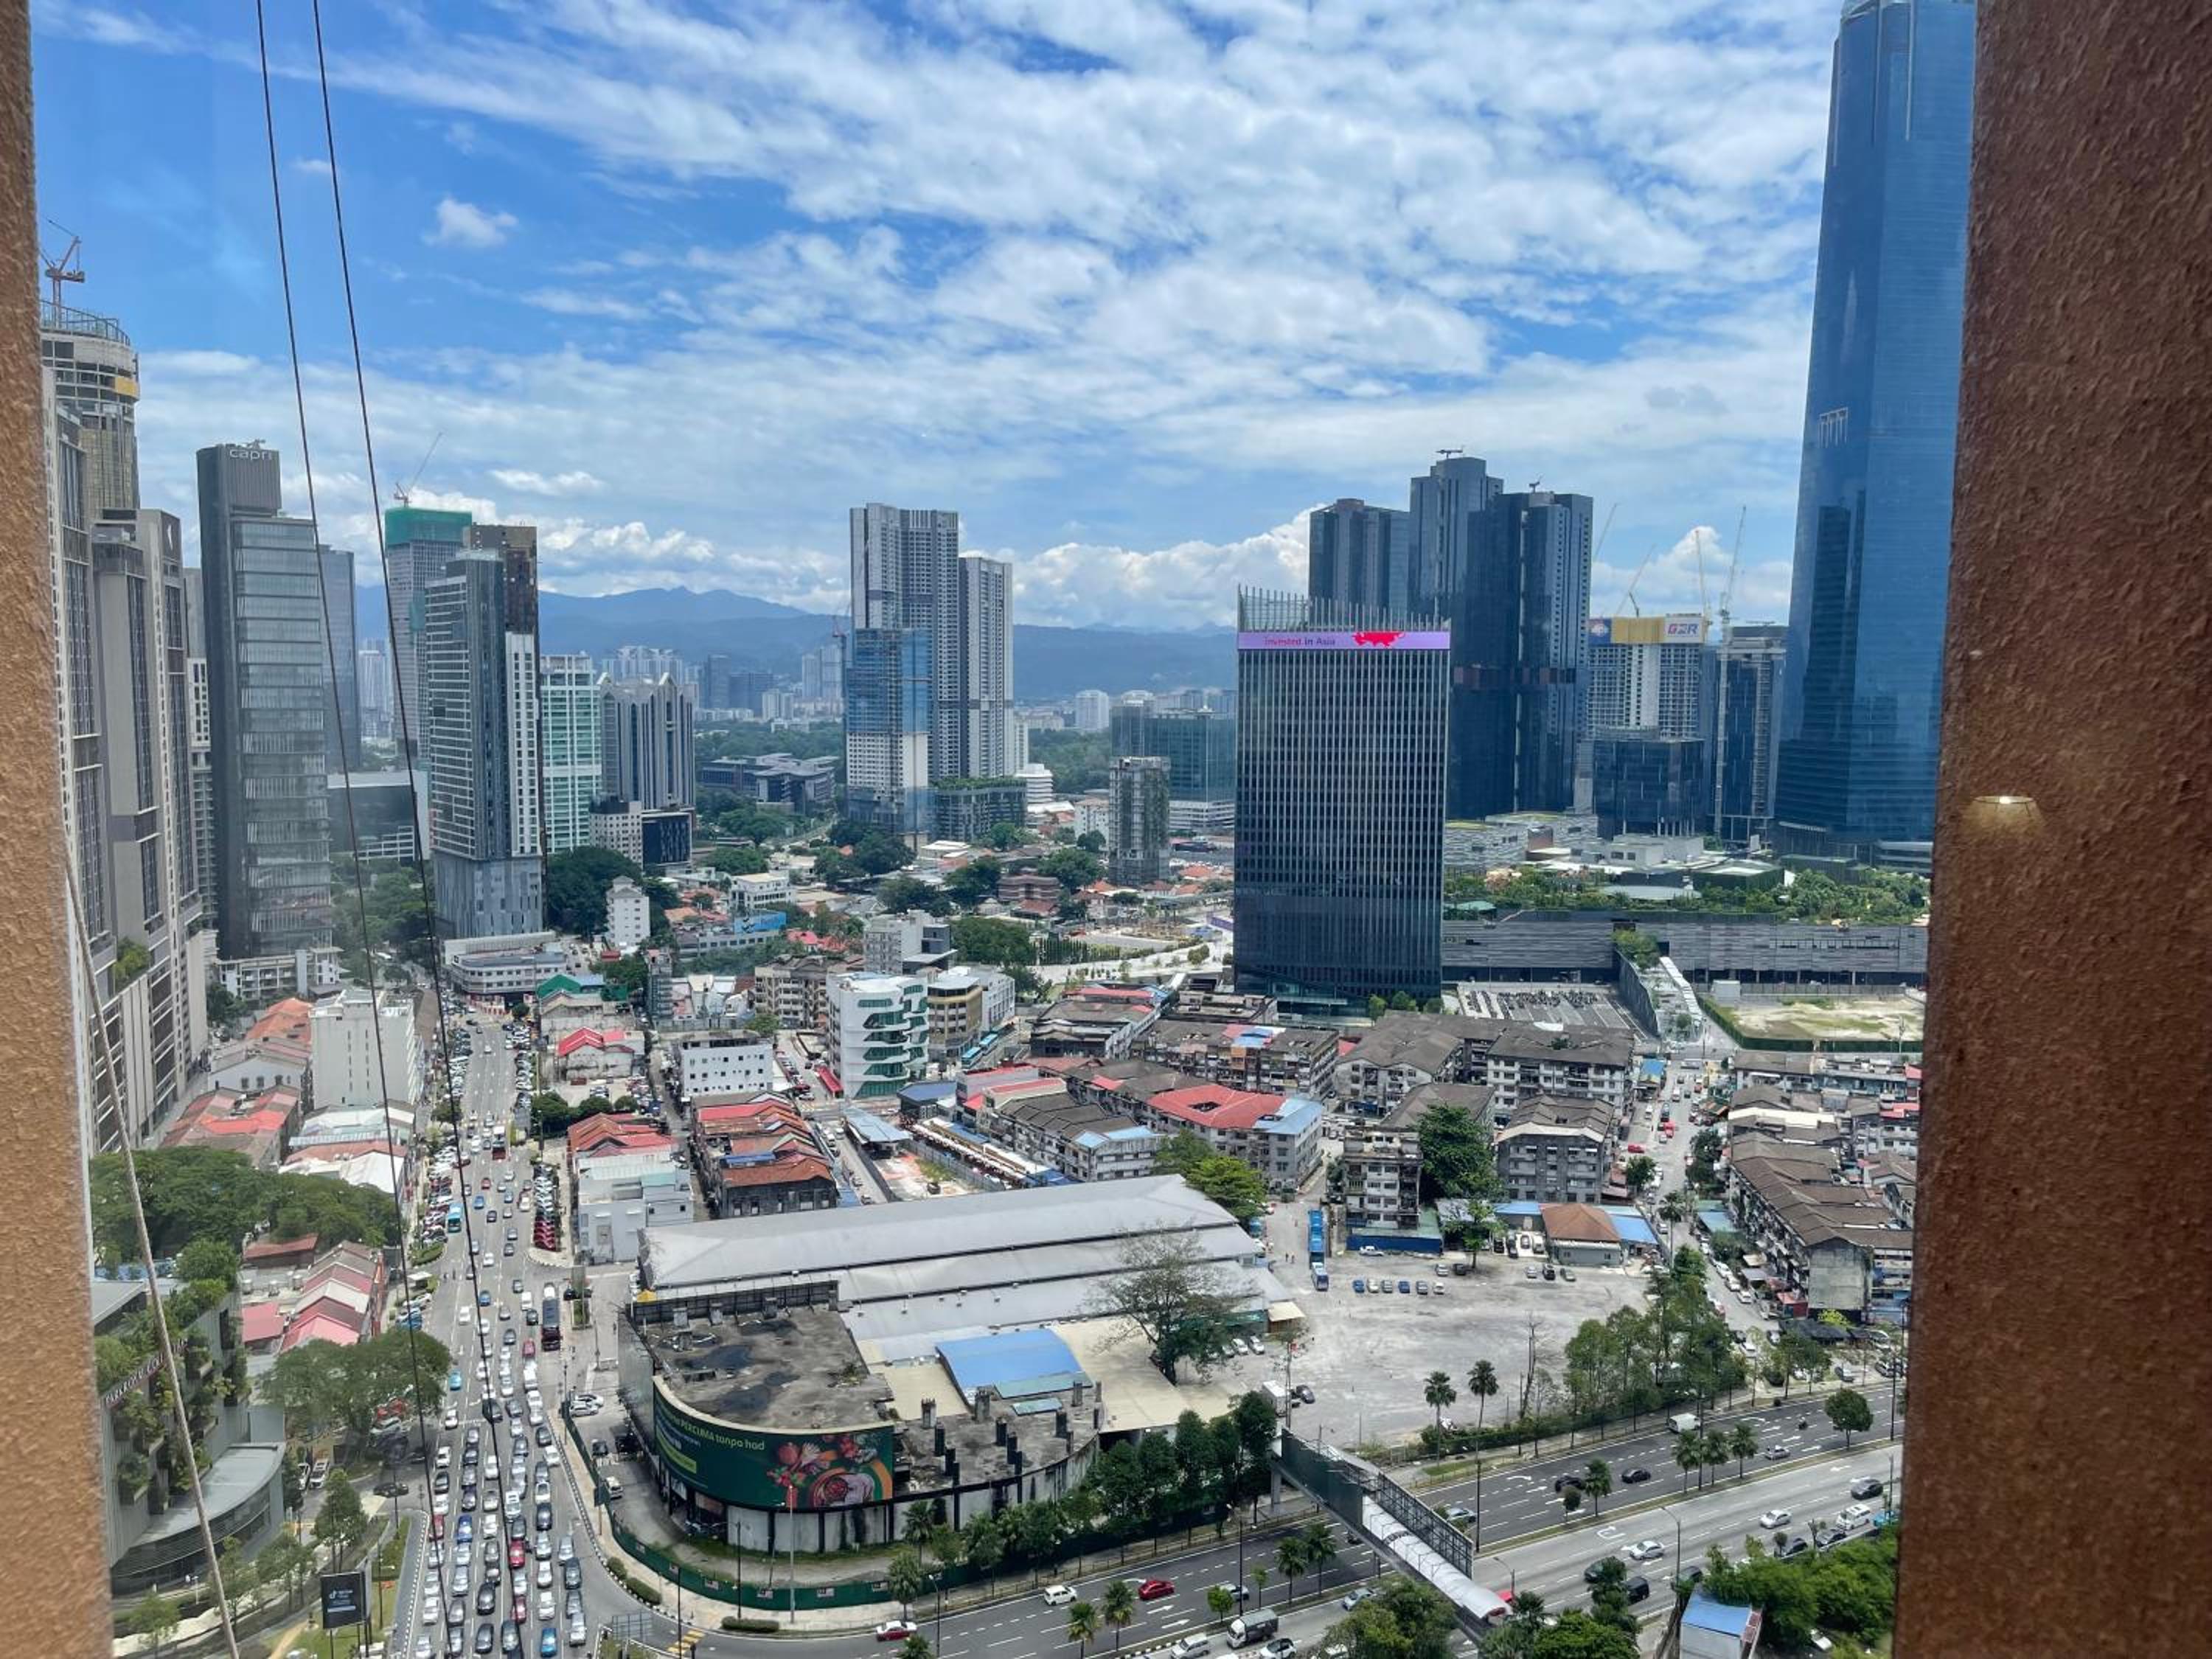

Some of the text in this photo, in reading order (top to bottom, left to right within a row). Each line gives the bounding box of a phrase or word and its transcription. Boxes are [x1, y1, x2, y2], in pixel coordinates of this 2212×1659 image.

[229, 449, 272, 460] capri
[1304, 636, 1313, 645] in
[1317, 637, 1335, 645] Asia
[745, 1439, 765, 1451] had
